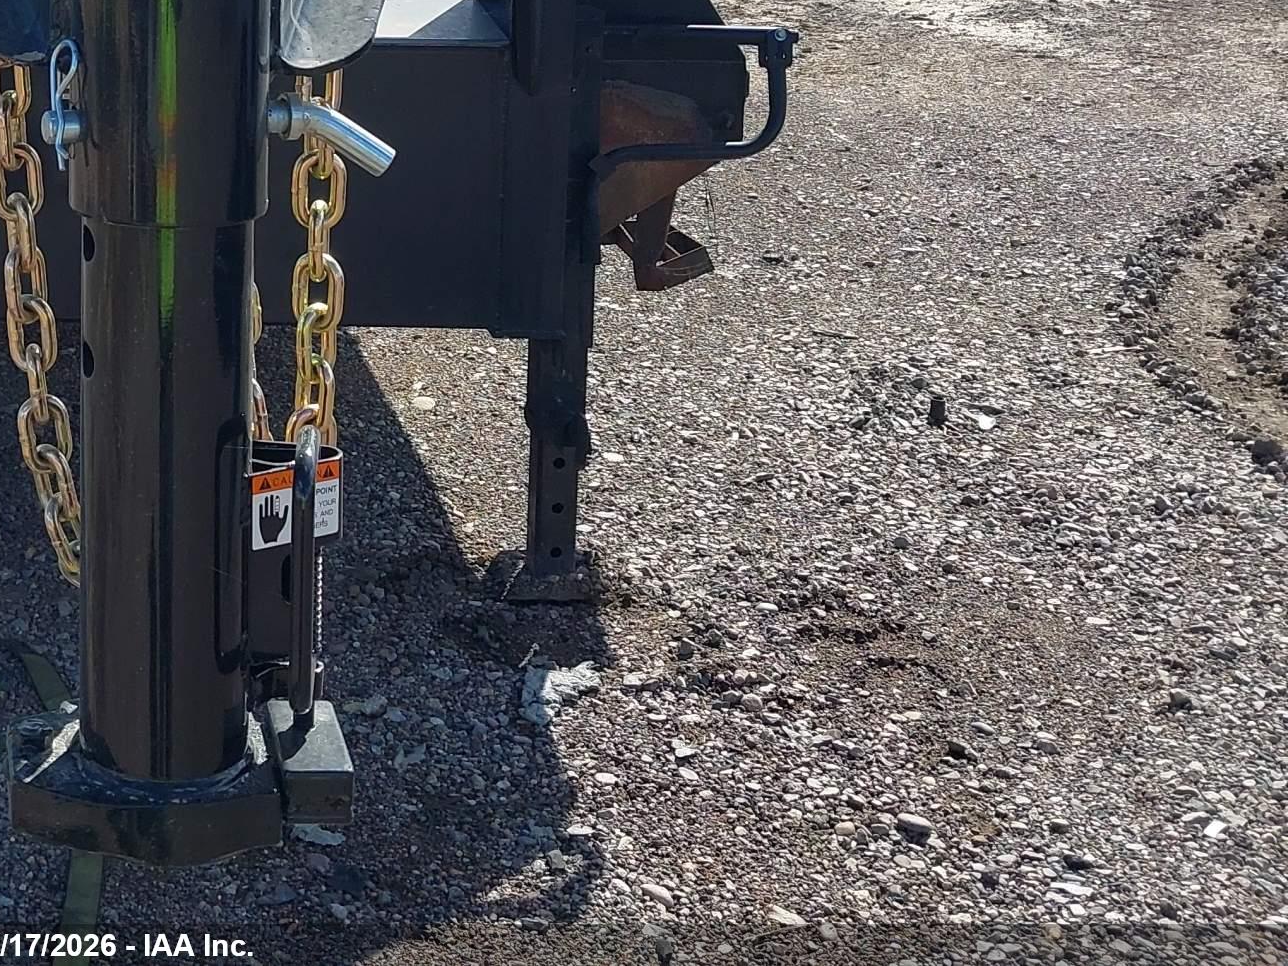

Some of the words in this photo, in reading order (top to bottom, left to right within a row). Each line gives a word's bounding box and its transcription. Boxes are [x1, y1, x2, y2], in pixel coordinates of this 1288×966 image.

[315, 485, 337, 496] POINT
[319, 498, 337, 508] YOUR
[320, 509, 334, 517] AND
